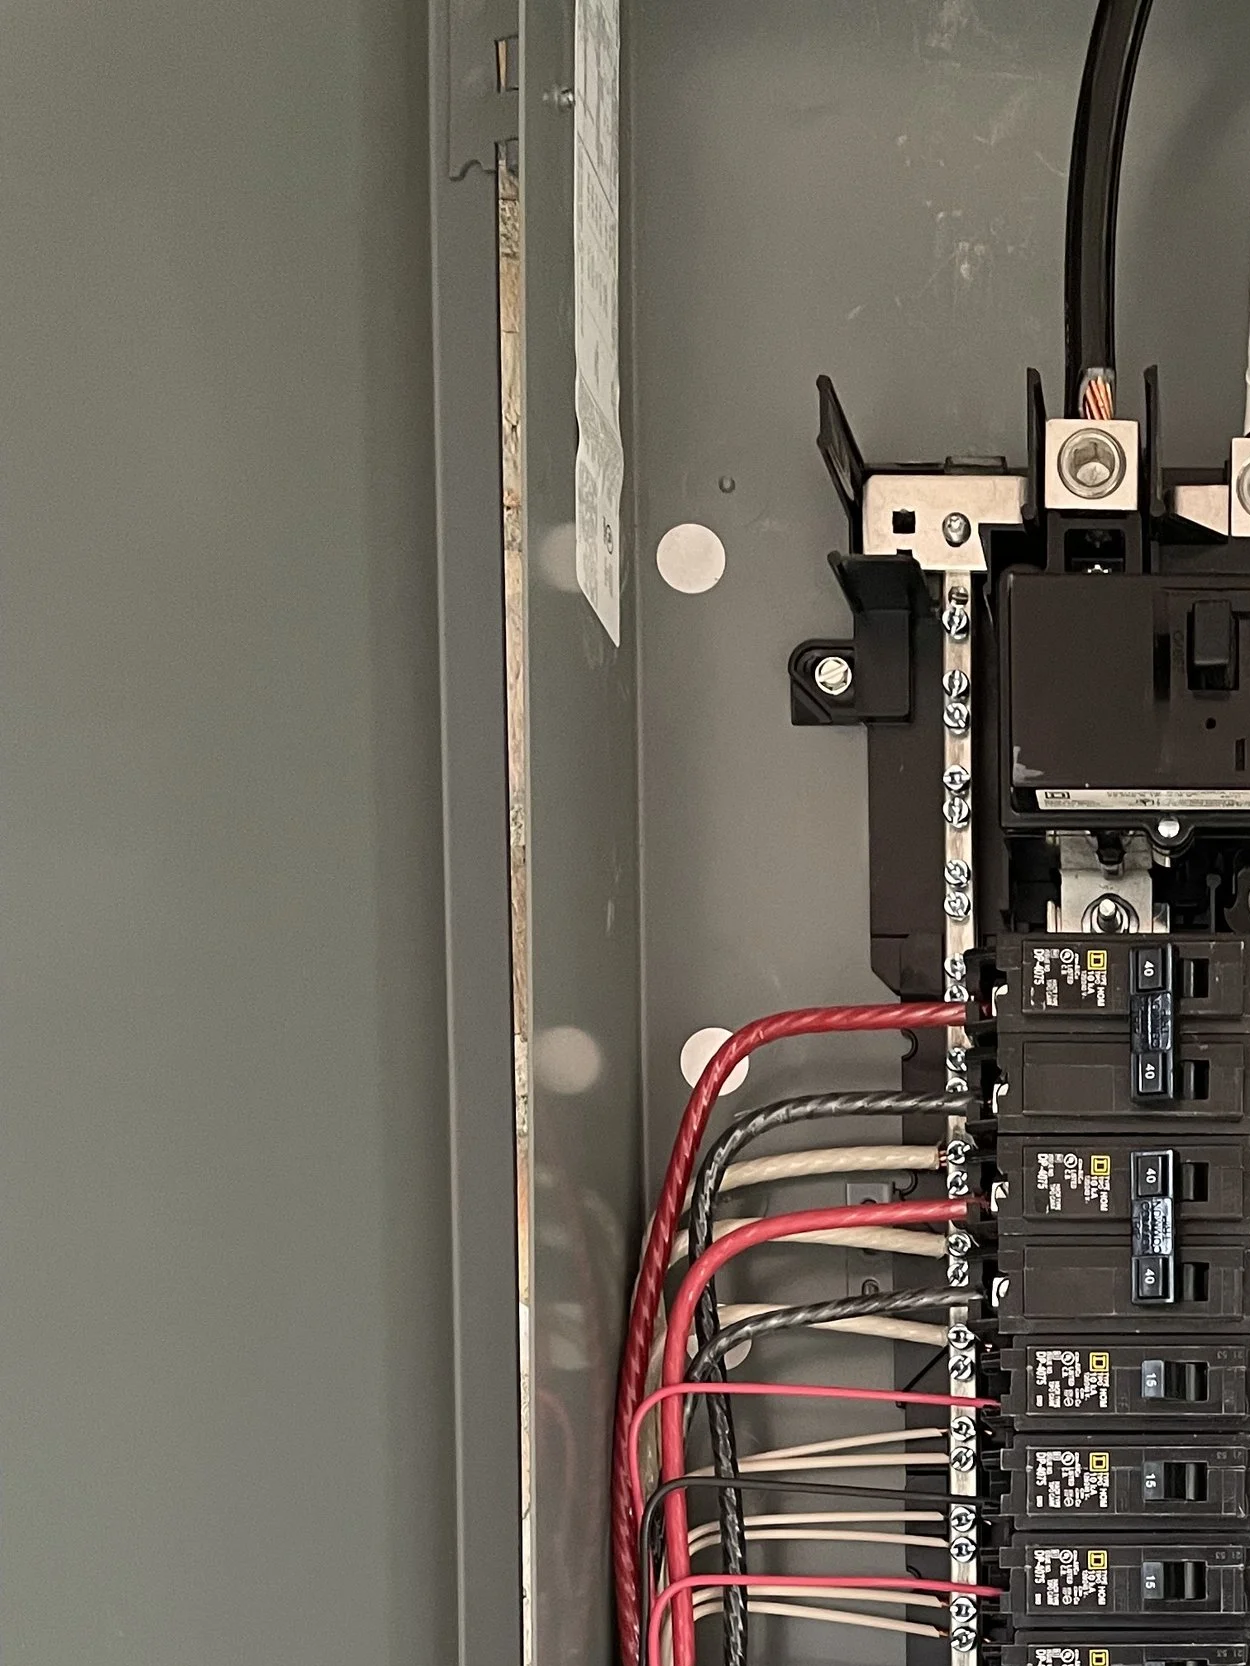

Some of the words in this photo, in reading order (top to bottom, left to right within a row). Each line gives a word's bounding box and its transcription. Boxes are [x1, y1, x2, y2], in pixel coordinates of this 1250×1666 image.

[1033, 949, 1044, 985] DP-4075
[1144, 961, 1154, 977] 40
[1097, 987, 1105, 1006] HOM
[1145, 1063, 1155, 1079] 40
[1037, 1154, 1048, 1189] DP-4075
[1146, 1168, 1156, 1184] 40
[1100, 1192, 1108, 1211] HOM
[1145, 1268, 1155, 1284] 40
[1036, 1351, 1046, 1385] DP-4075
[1146, 1373, 1156, 1388] 15
[1100, 1388, 1108, 1408] HOM
[1036, 1452, 1046, 1486] DP-4075
[1146, 1473, 1156, 1488] 15
[1100, 1488, 1108, 1508] HOM
[1034, 1550, 1045, 1584] DP-4075
[1146, 1574, 1156, 1589] 15
[1098, 1586, 1106, 1605] HOM
